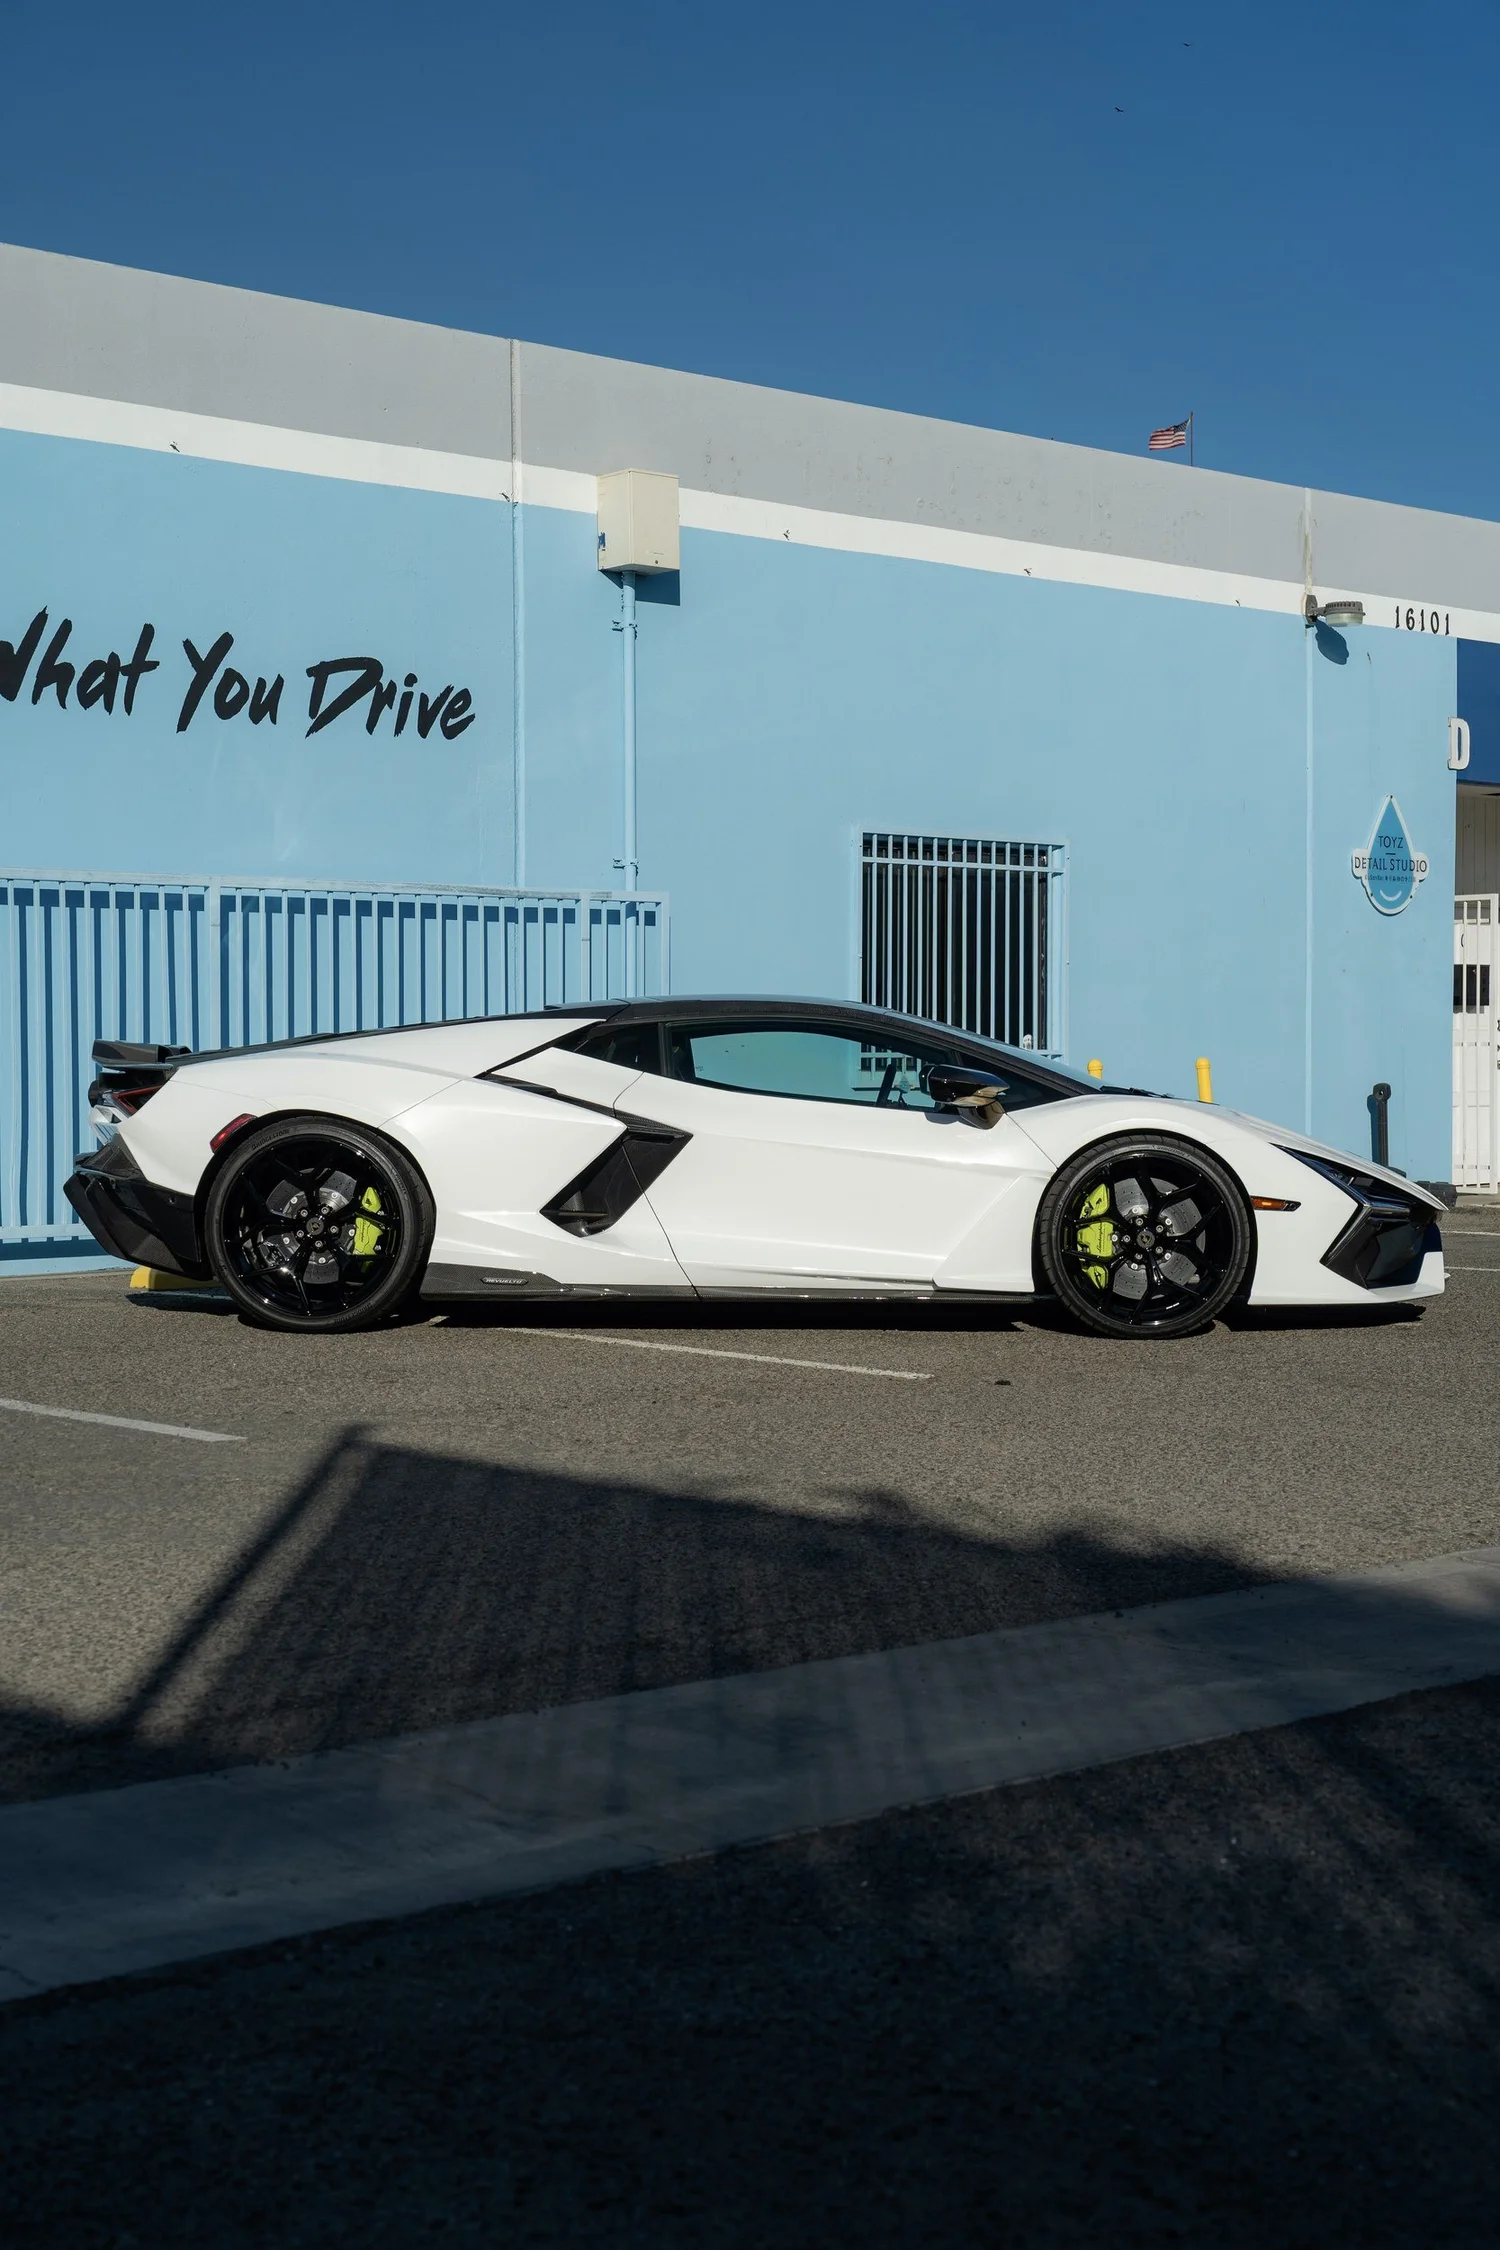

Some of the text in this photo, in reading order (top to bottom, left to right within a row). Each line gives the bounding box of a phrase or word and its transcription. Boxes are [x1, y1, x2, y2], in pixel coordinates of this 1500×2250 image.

[1395, 605, 1450, 636] 16101
[176, 631, 285, 733] You
[305, 656, 476, 741] Drive
[1448, 716, 1471, 771] D
[1378, 835, 1404, 849] TOYZ
[1354, 857, 1428, 873] DETAIL STUDIO
